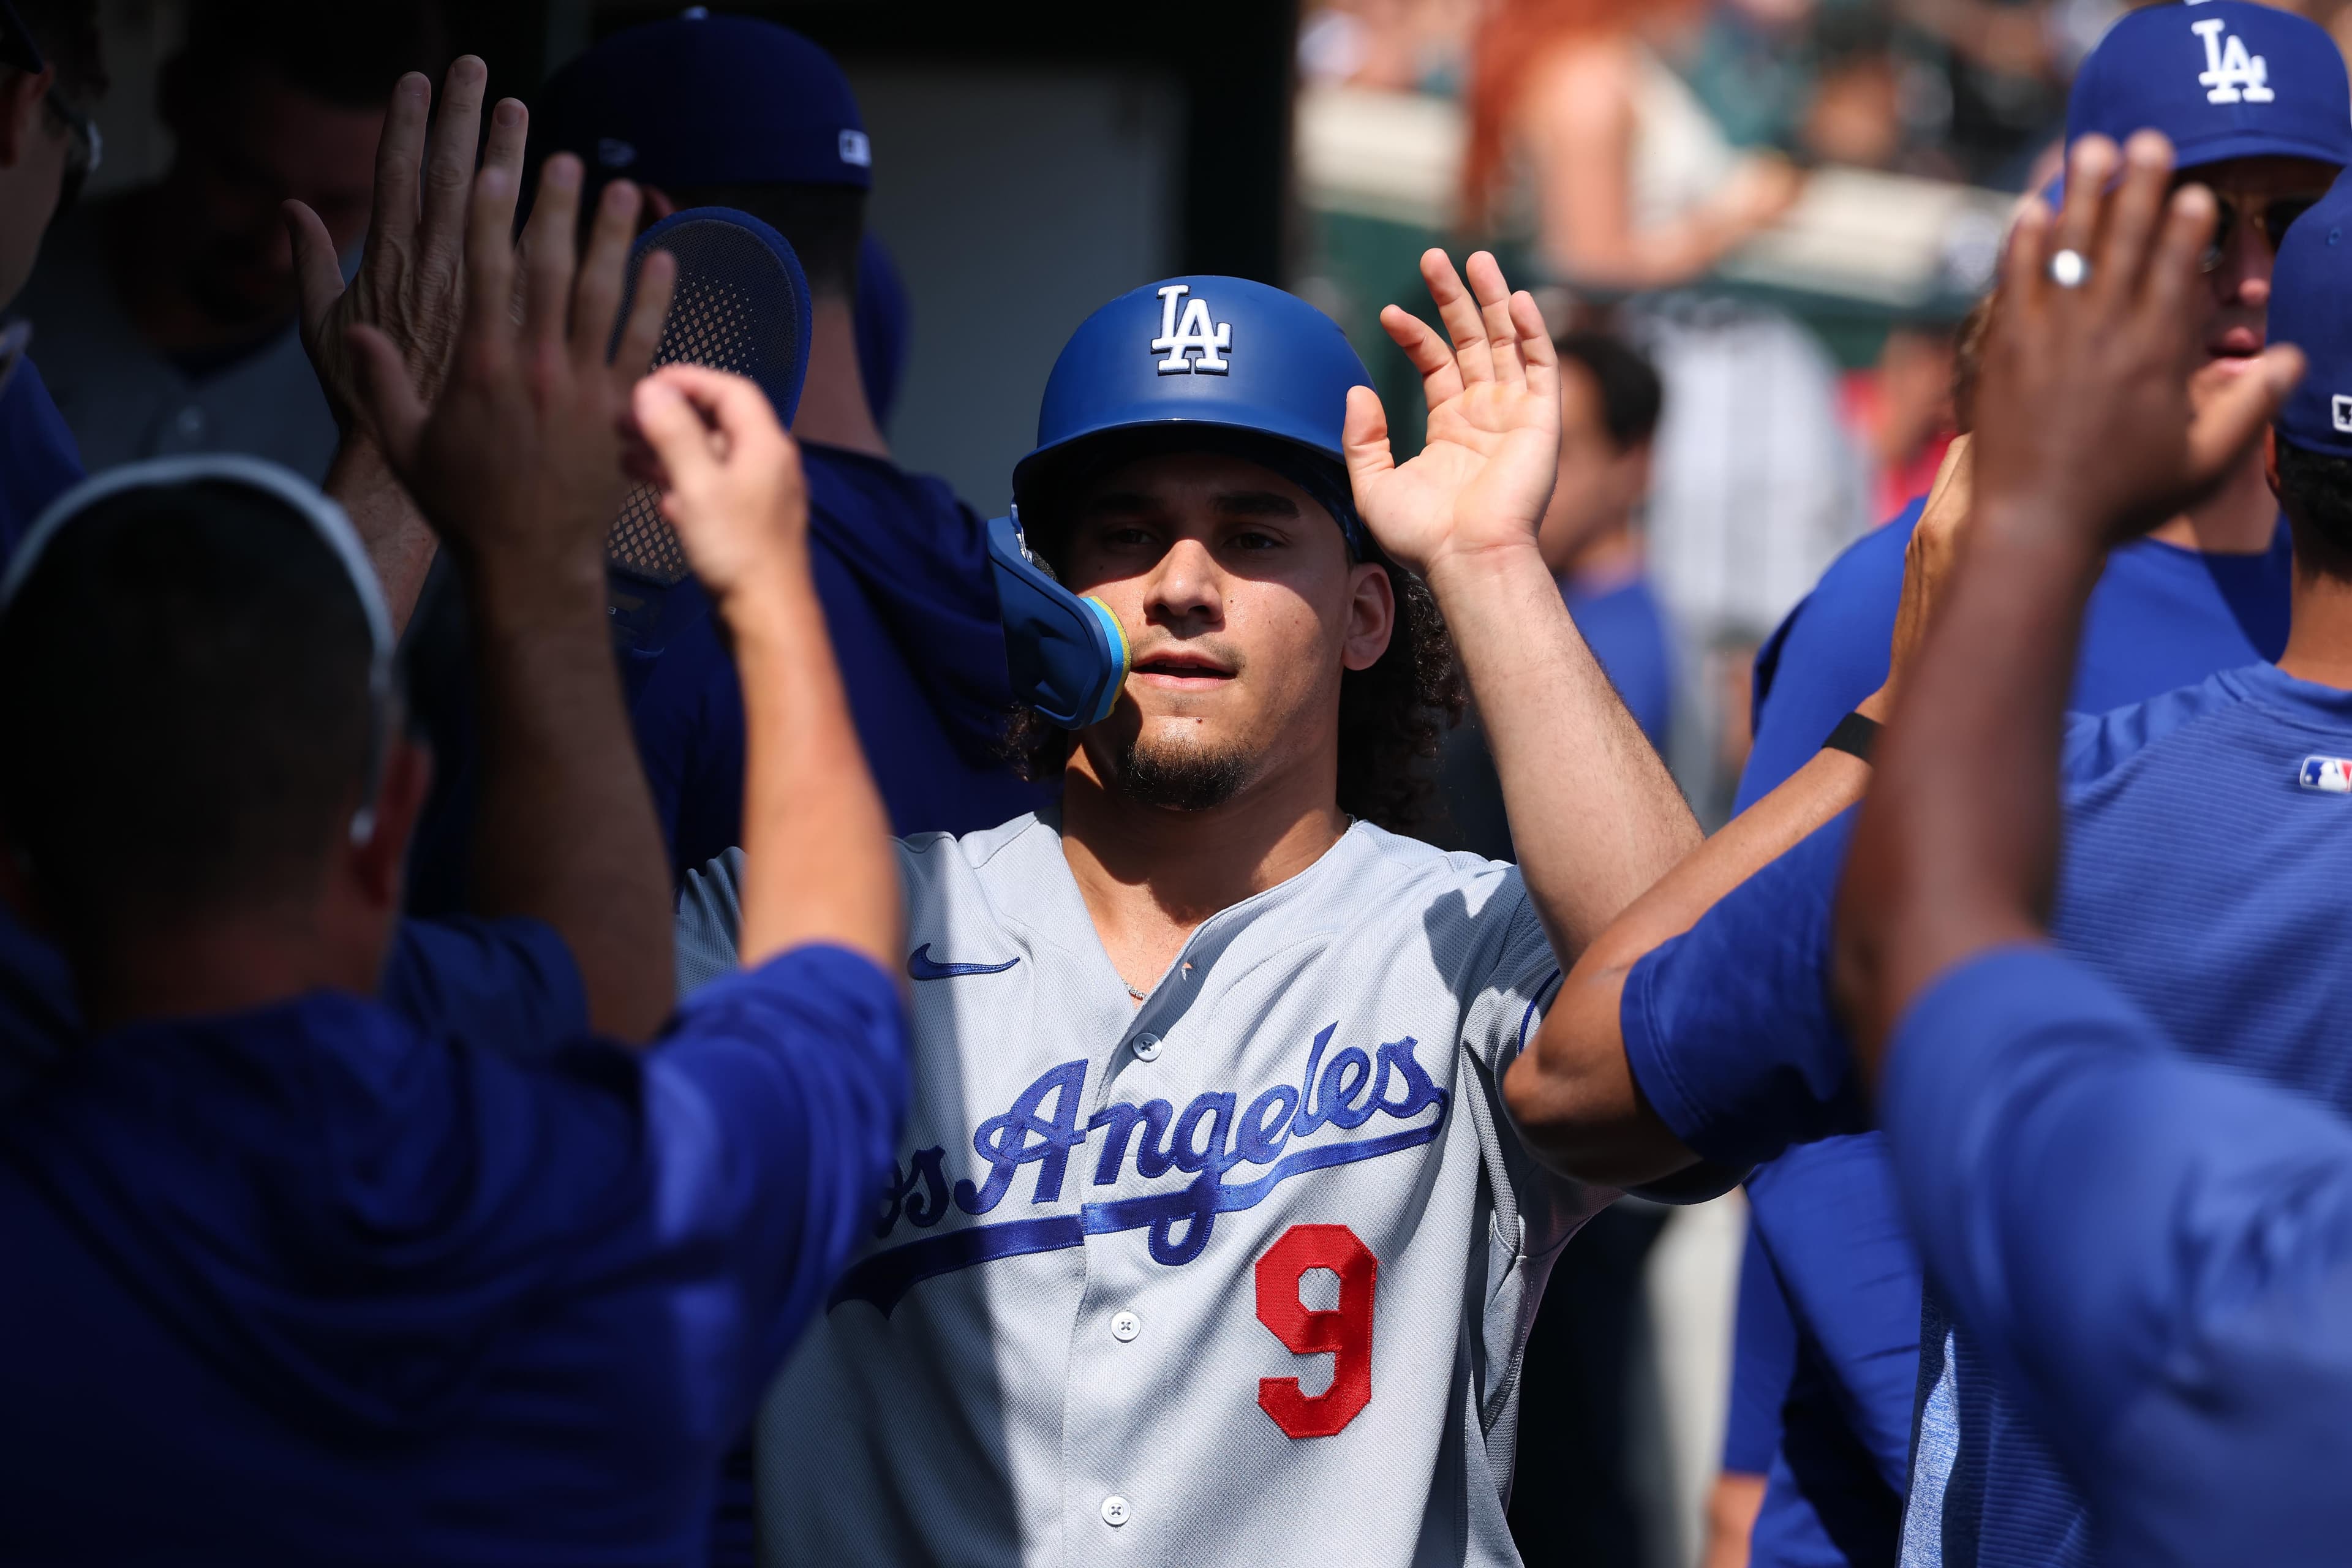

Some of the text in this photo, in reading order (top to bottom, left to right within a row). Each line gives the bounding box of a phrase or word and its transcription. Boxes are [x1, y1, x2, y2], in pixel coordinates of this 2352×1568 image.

[2191, 18, 2275, 104] LA
[1151, 285, 1232, 375] LA
[954, 1020, 1441, 1266] Angeles
[1255, 1223, 1378, 1439] 9
